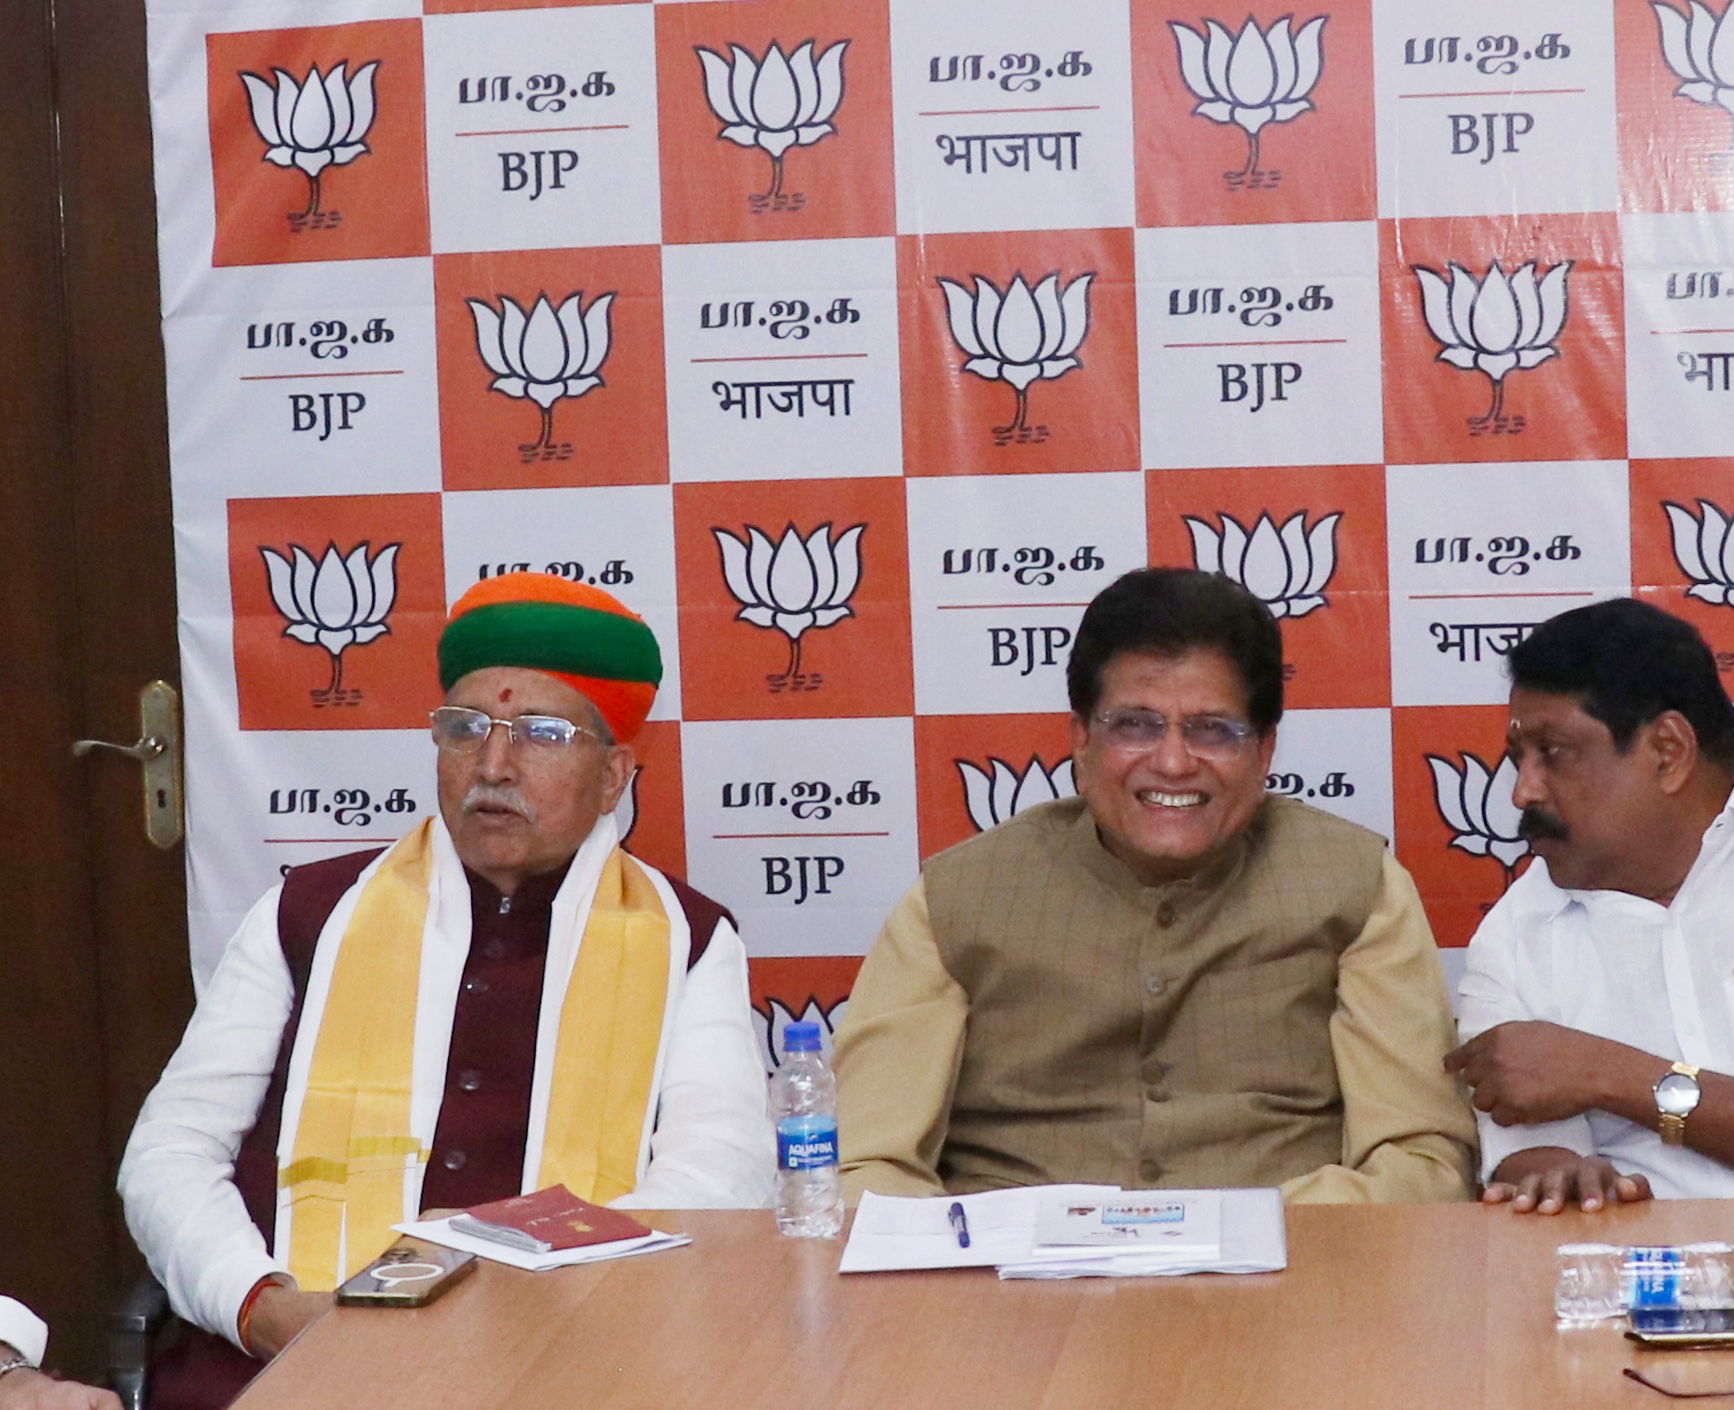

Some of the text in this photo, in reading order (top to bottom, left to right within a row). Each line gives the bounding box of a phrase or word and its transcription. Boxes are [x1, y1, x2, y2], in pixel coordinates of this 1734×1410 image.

[929, 50, 1093, 93] பா.ஜ.க
[1404, 33, 1572, 76] பா.ஜ.க
[458, 70, 616, 113] பா.ஜ.க
[935, 131, 1083, 175] भाजपा
[1447, 112, 1535, 165] BJP
[497, 149, 579, 202] BJP
[700, 297, 861, 340] பா.ஜ.க
[1168, 284, 1334, 328] பா.ஜ.க
[247, 317, 395, 360] பா.ஜ.க
[711, 378, 855, 420] भाजपा
[1216, 361, 1303, 414] BJP
[288, 391, 366, 442] BJP
[942, 545, 1106, 586] பா.ஜ.க
[1414, 534, 1582, 576] பா.ஜ.க
[986, 626, 1072, 677] BJP
[1428, 621, 1545, 662] भाज
[269, 788, 417, 827] பா.ஜ.க
[721, 780, 882, 821] பா.ஜ.க
[760, 855, 845, 906] BJP
[788, 1141, 834, 1158] AQUAFINA
